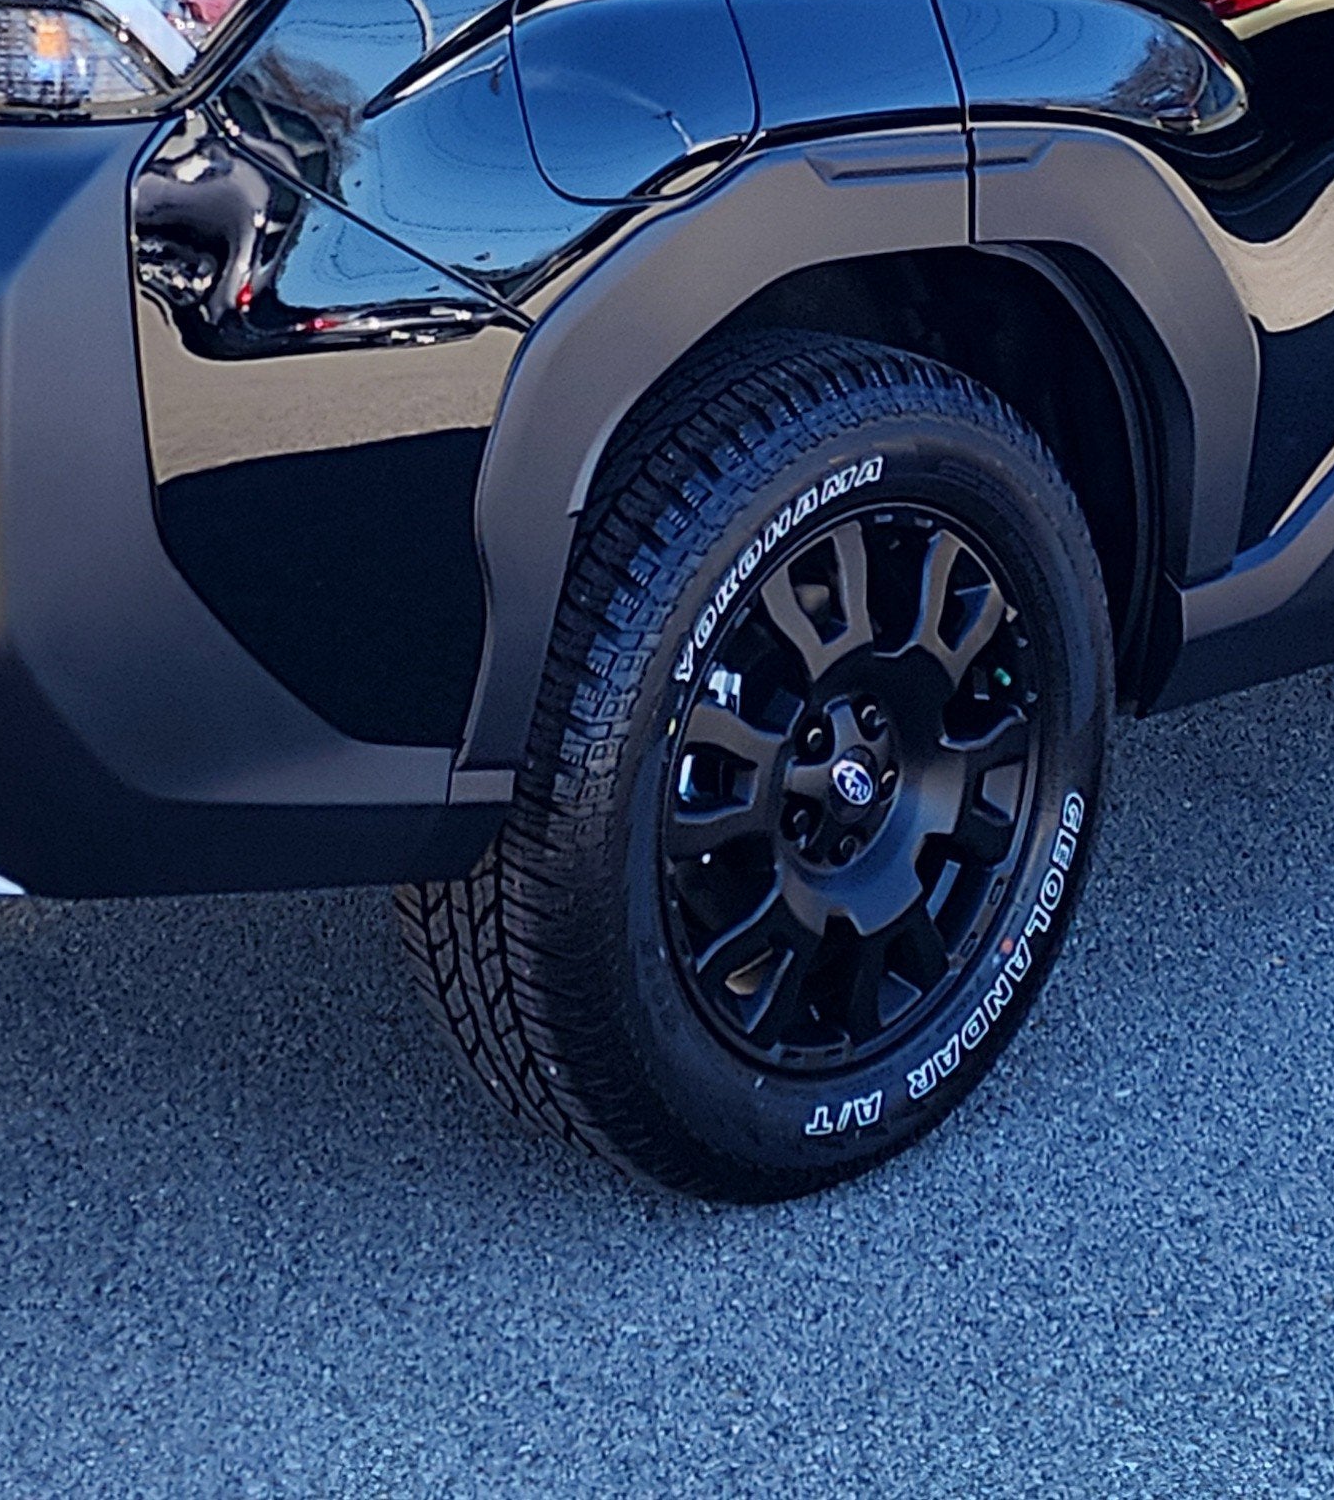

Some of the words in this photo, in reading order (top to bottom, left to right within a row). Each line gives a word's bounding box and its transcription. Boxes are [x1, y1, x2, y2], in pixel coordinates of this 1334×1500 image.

[673, 455, 884, 683] YOKOHAMA
[906, 791, 1085, 1100] GEOLANDAR
[804, 1090, 883, 1136] A/T
